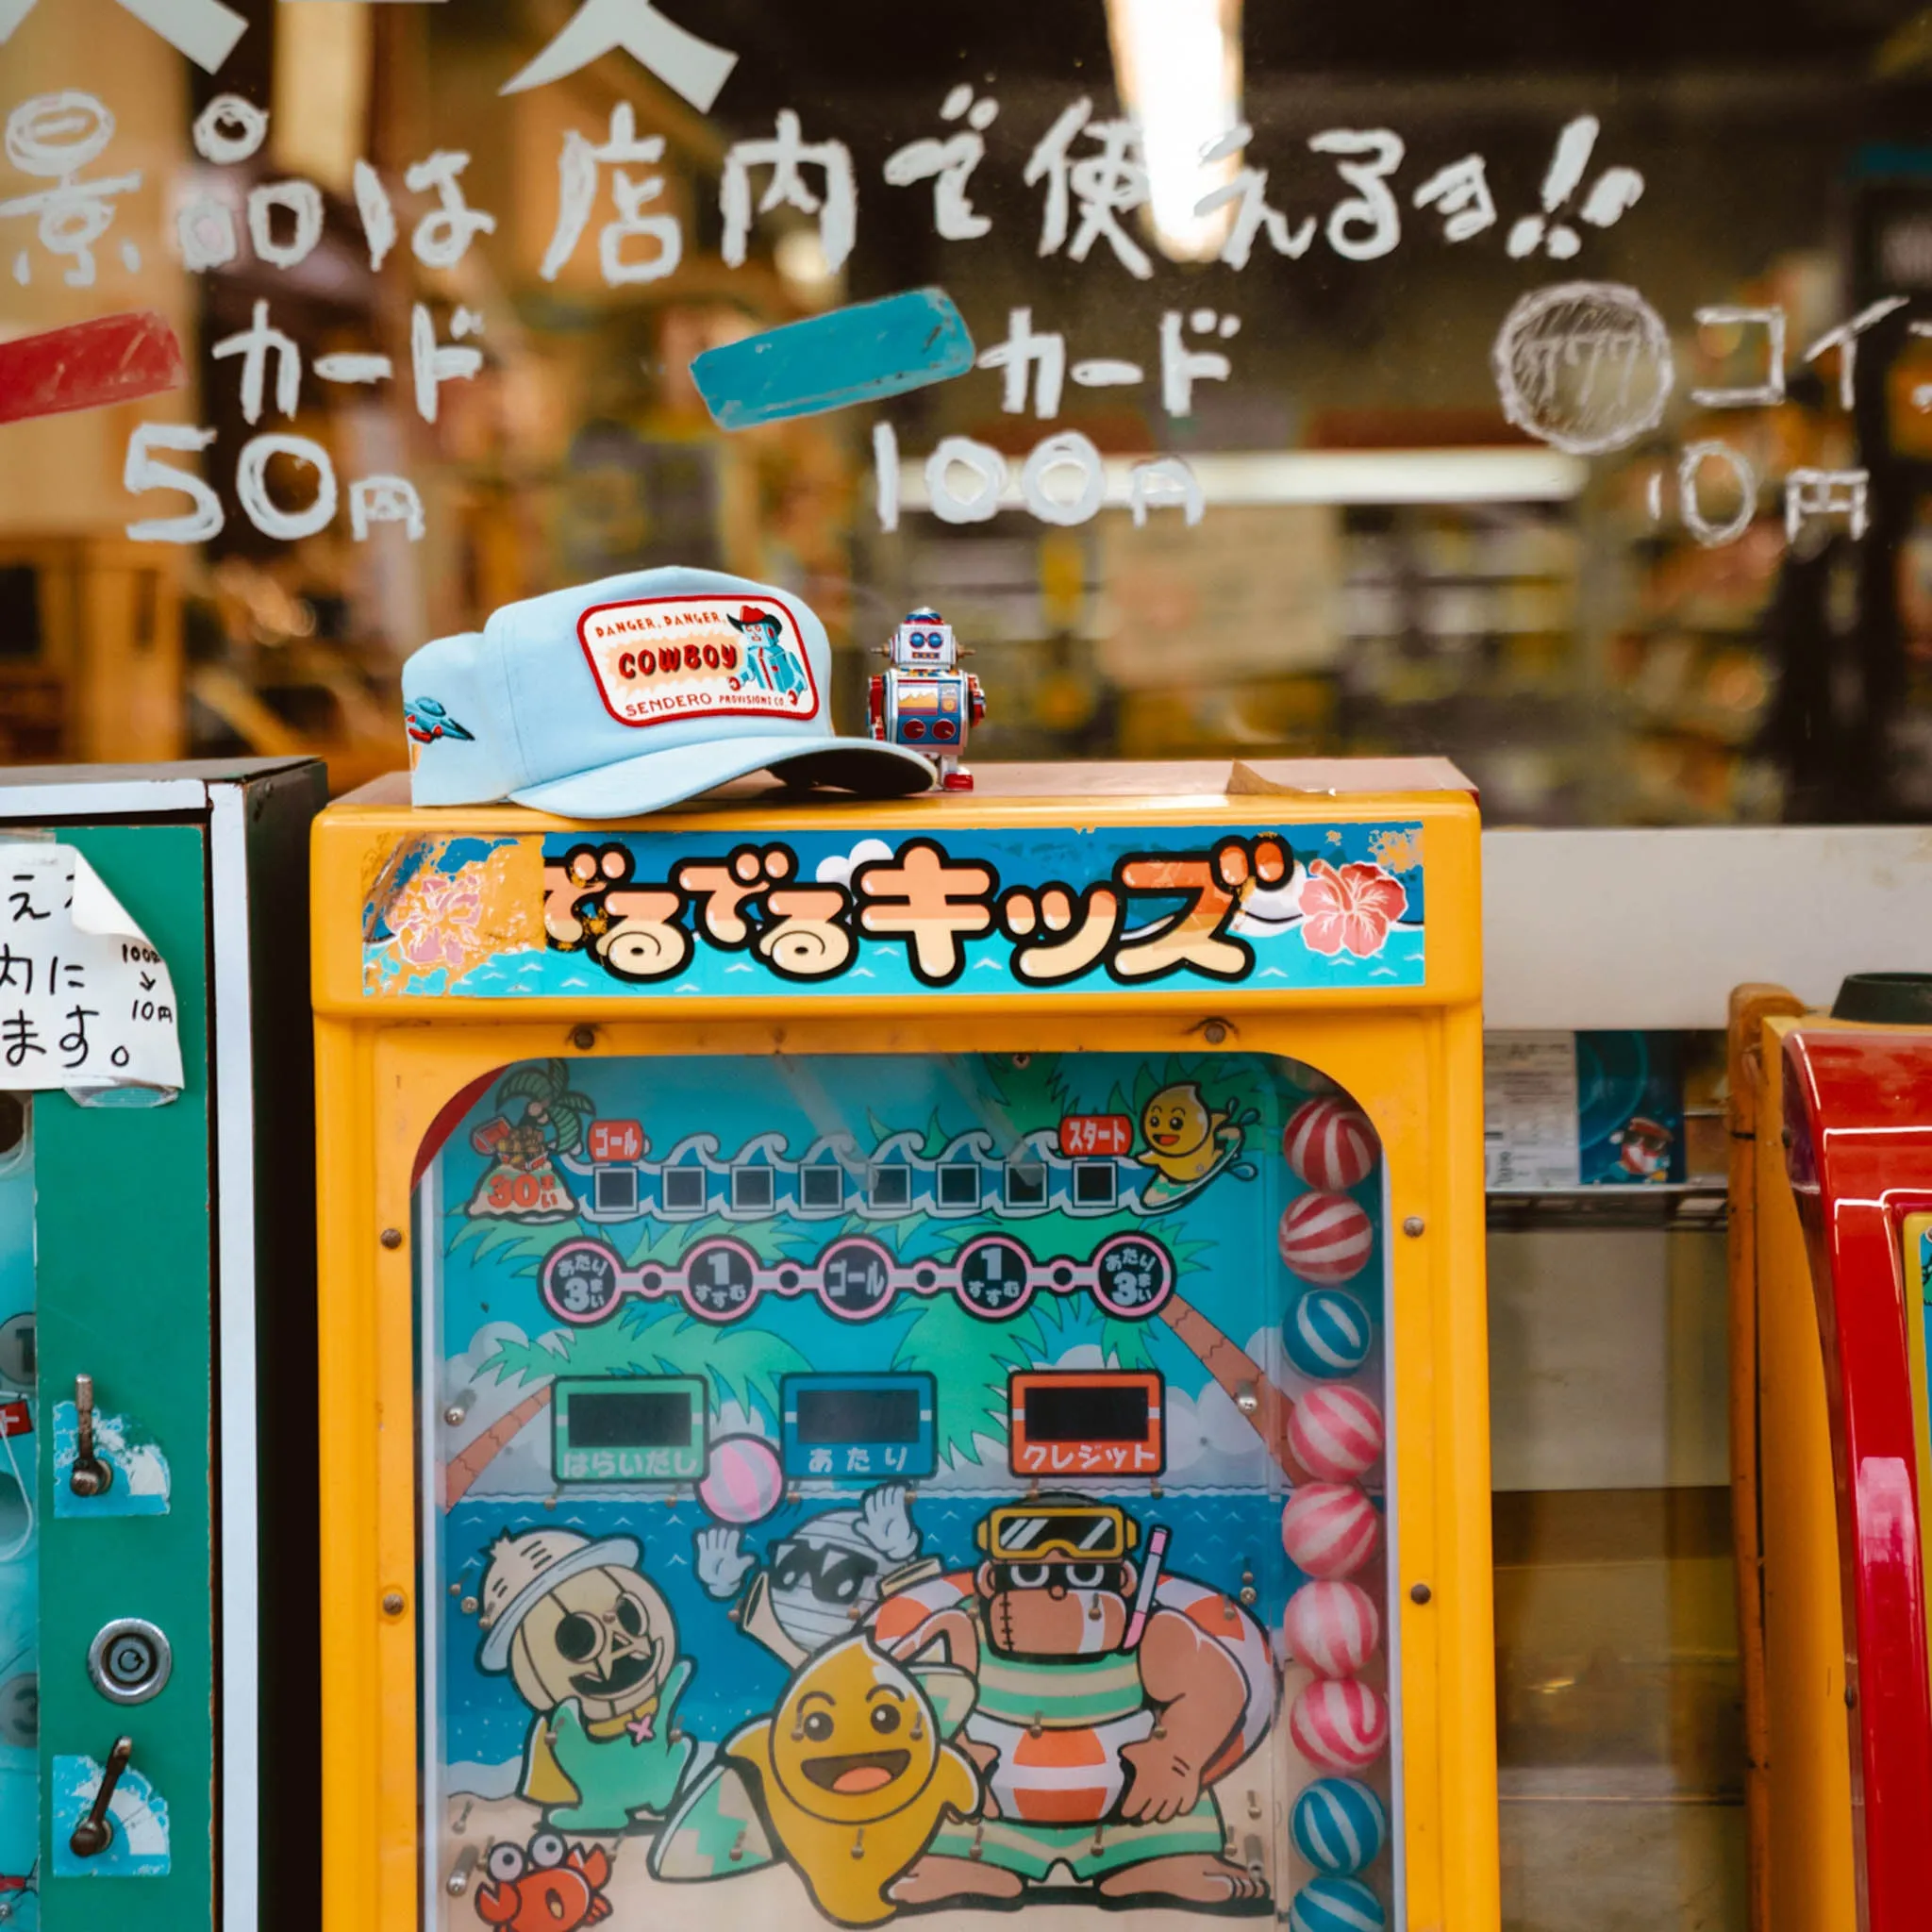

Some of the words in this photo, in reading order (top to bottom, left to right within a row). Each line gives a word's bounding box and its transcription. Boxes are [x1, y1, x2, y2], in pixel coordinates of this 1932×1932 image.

[213, 299, 485, 425] カード
[977, 307, 1236, 418] カード
[124, 423, 426, 544] 50円
[873, 421, 1206, 532] 100円
[619, 643, 738, 679] COWBOY
[625, 692, 712, 717] SENDERO
[131, 999, 174, 1024] 10円
[2, 1005, 130, 1069] ます。
[1069, 1119, 1125, 1152] スタート
[708, 1253, 730, 1285] 1
[980, 1247, 1003, 1280] 1
[808, 1447, 908, 1473] あたり
[1023, 1444, 1156, 1470] クレジット
